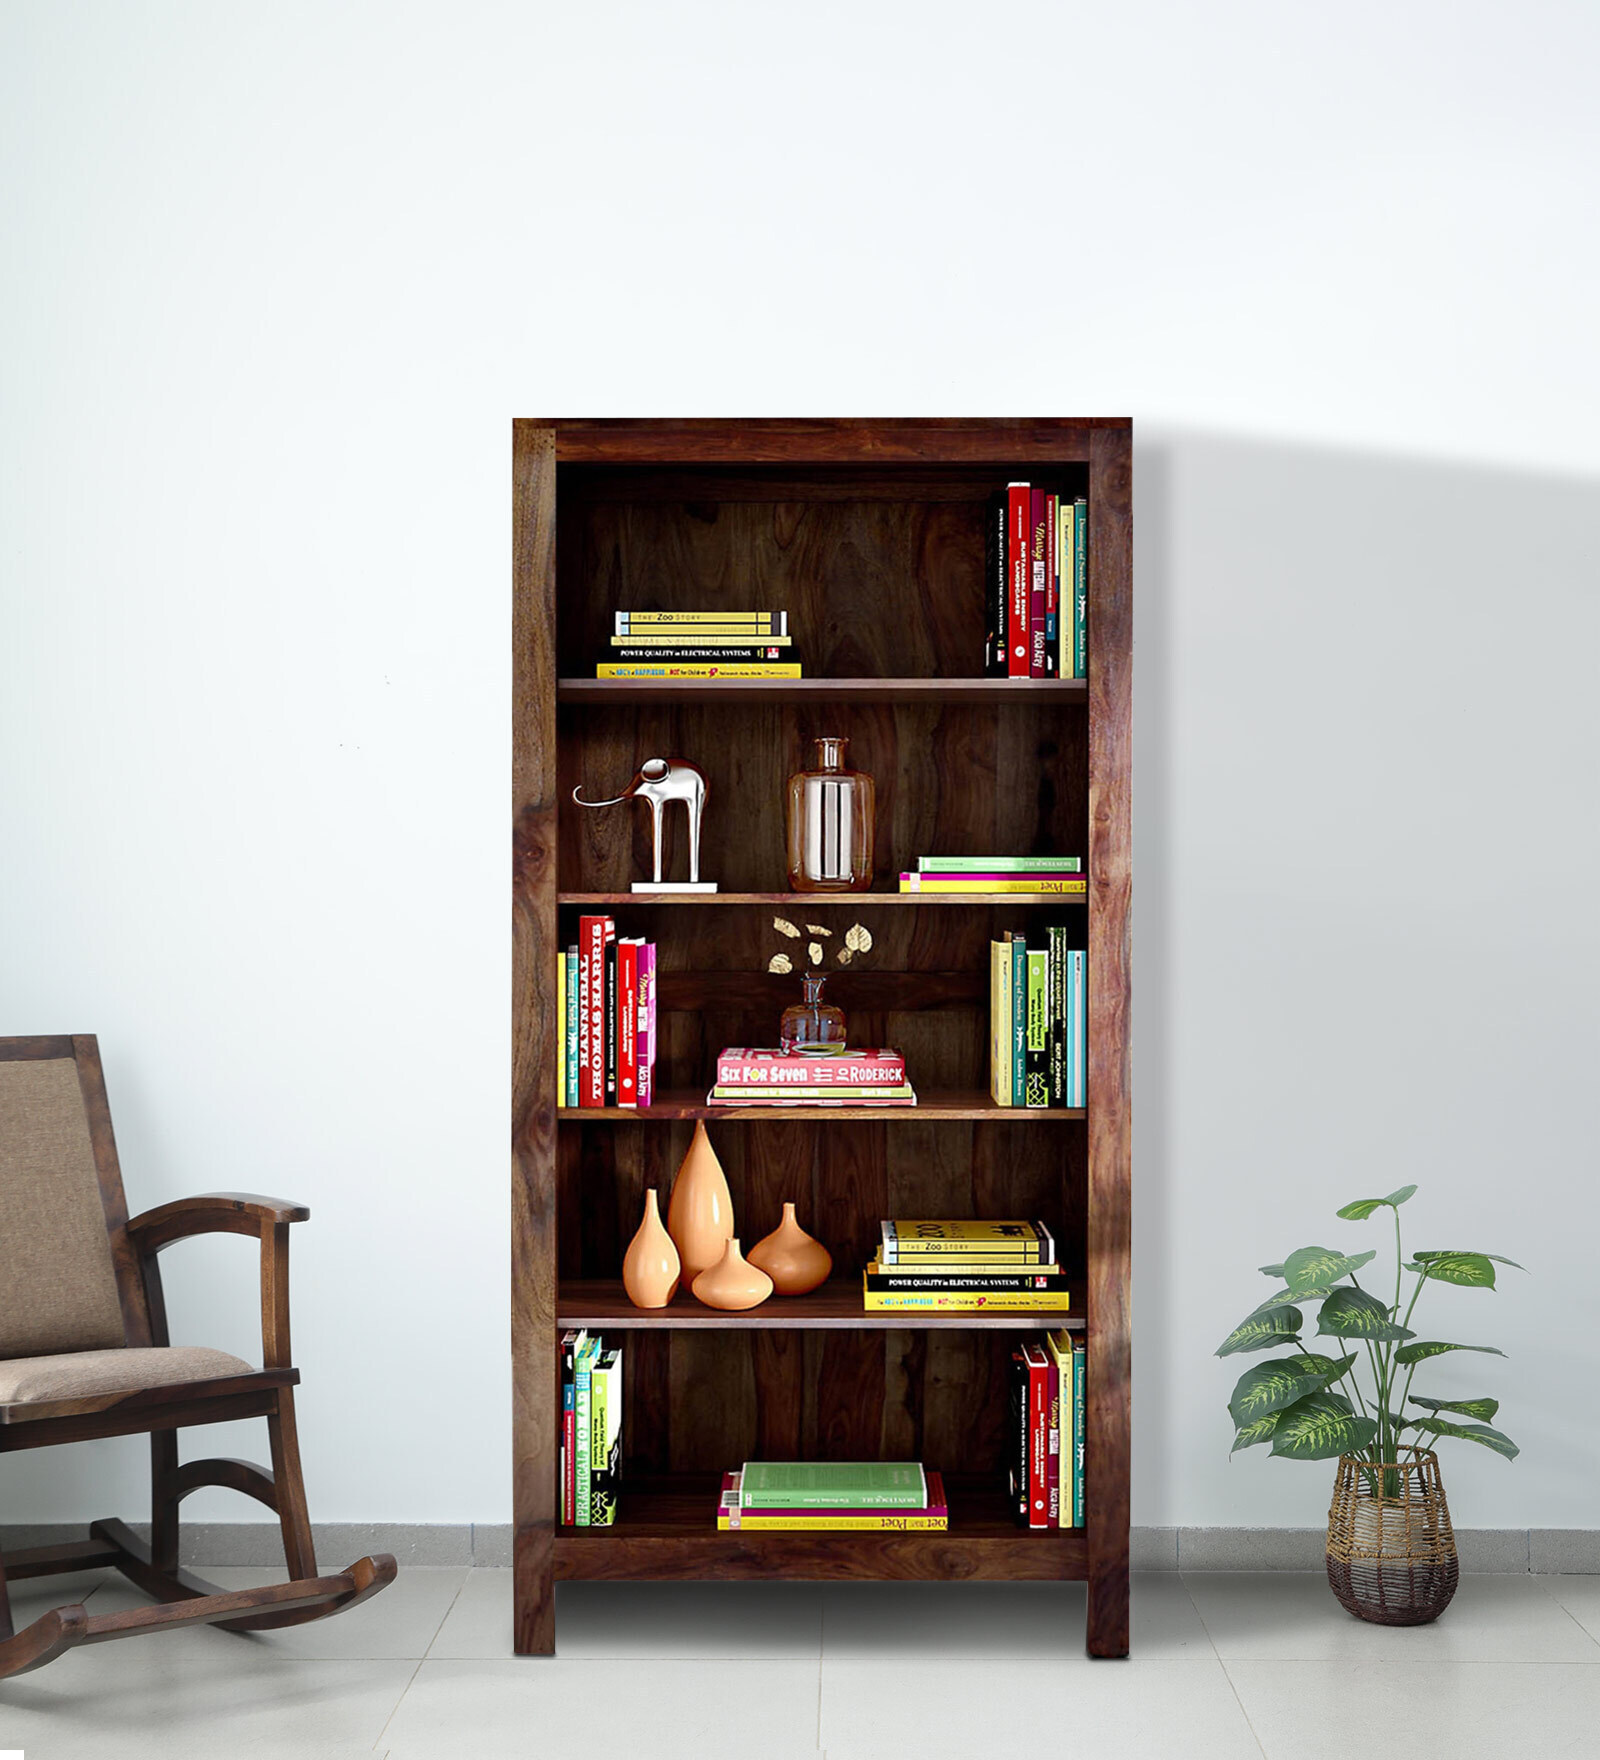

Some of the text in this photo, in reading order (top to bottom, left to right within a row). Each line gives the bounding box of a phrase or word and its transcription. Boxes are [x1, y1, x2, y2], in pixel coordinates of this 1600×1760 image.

[1040, 883, 1063, 893] Poet
[580, 954, 589, 1068] HANNIBAL
[592, 924, 602, 1099] THOMAS HARRIS
[770, 1066, 807, 1082] Seven
[850, 1066, 902, 1082] RODERICK
[578, 1454, 588, 1517] PRACTICAL
[881, 1519, 906, 1530] Poet
